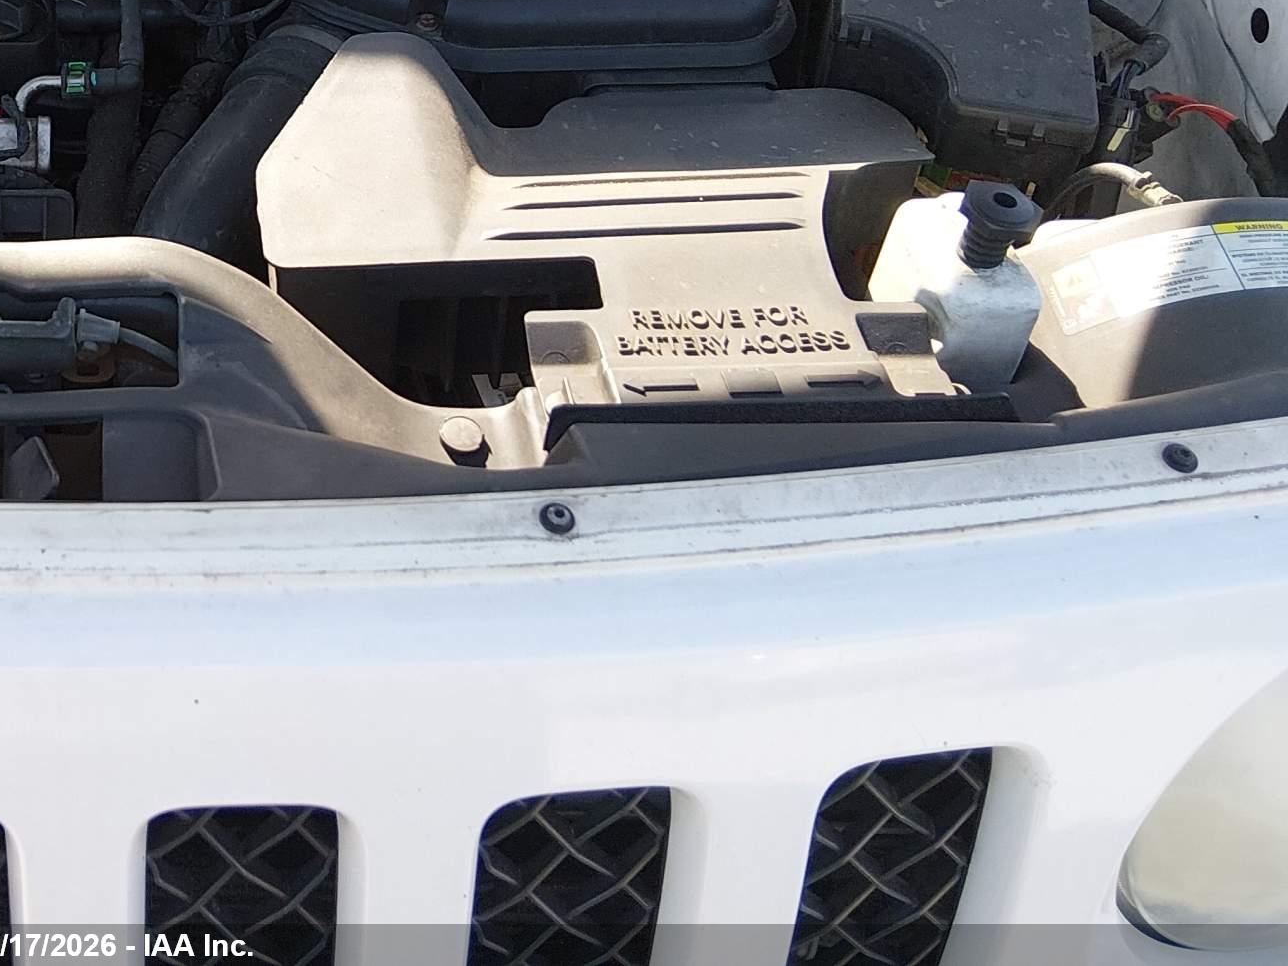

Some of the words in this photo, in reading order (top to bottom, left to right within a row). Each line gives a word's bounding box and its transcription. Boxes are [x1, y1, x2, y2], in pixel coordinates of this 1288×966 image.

[1235, 223, 1283, 231] WARNING
[631, 309, 746, 330] REMOVE
[752, 306, 809, 327] FOR
[617, 336, 730, 356] BATTERY
[742, 330, 851, 355] ACCESS
